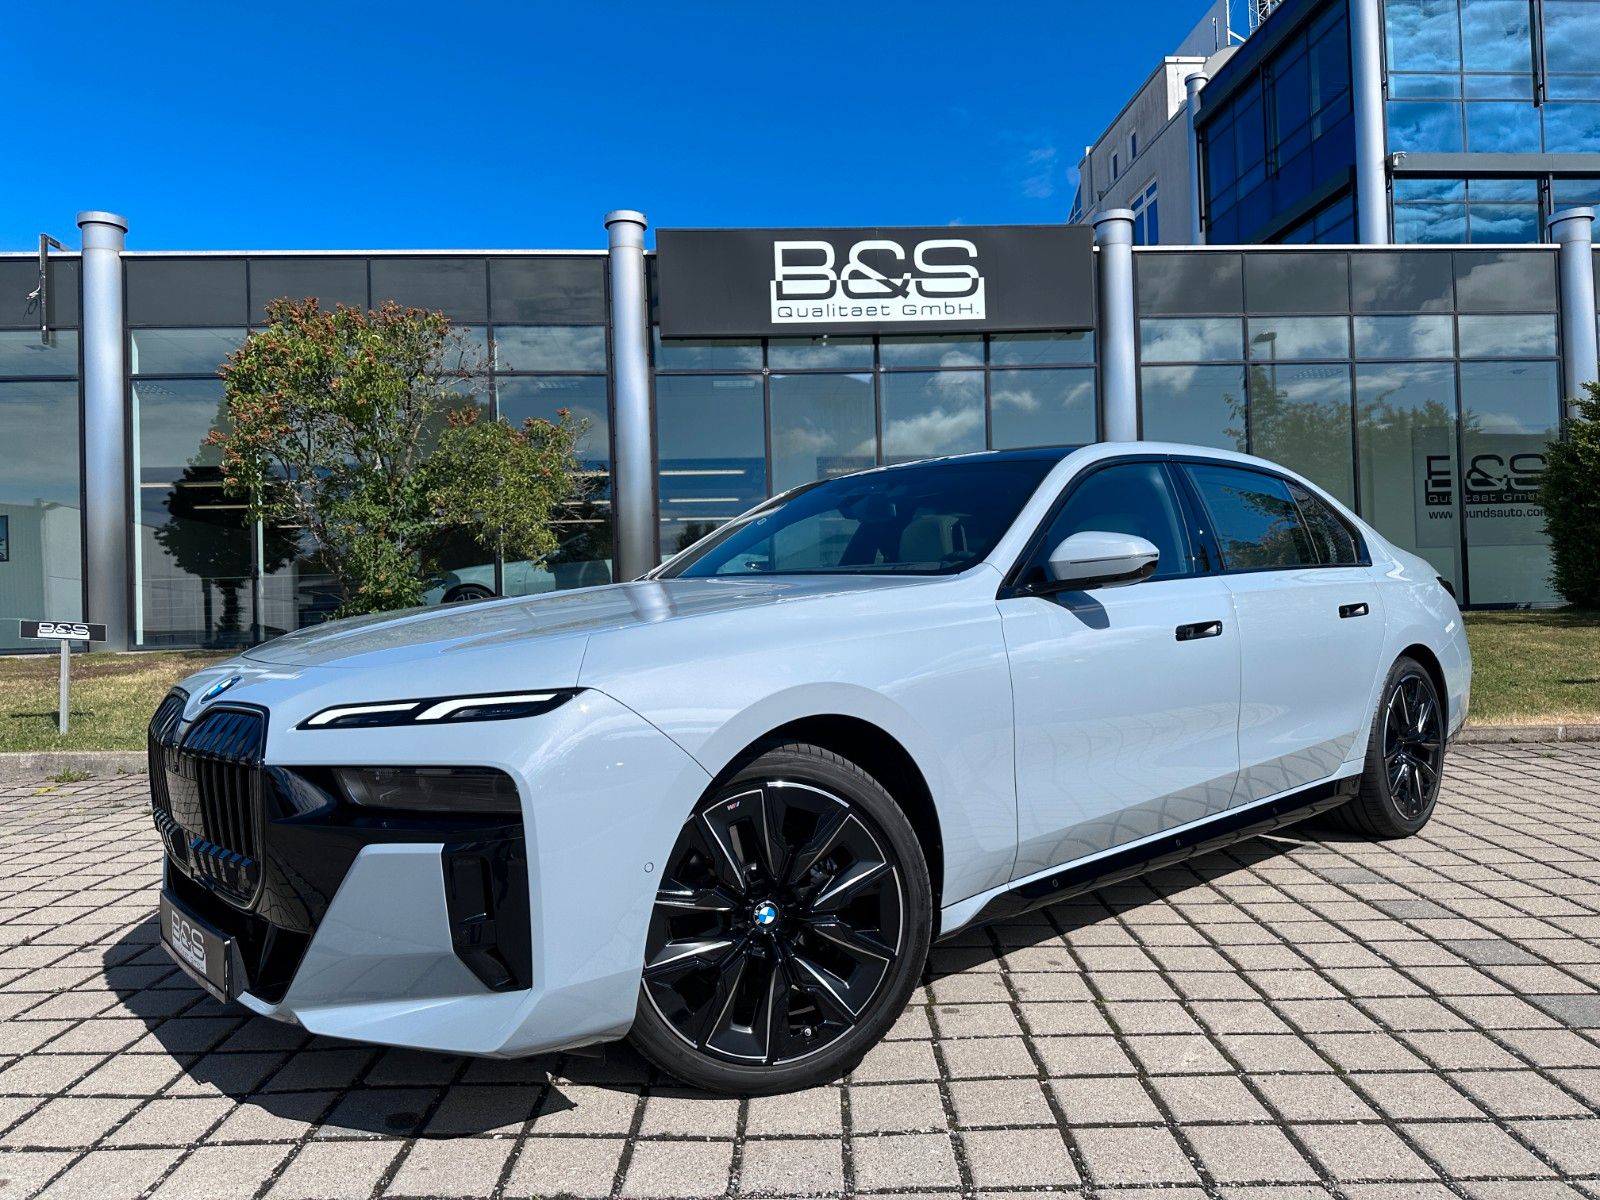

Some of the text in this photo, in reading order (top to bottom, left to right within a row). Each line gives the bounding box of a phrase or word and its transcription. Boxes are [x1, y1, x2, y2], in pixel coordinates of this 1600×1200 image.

[773, 239, 979, 301] B&S
[777, 301, 980, 318] Qualitaet GmbH.
[38, 622, 89, 636] B&S
[171, 909, 205, 961] B&S
